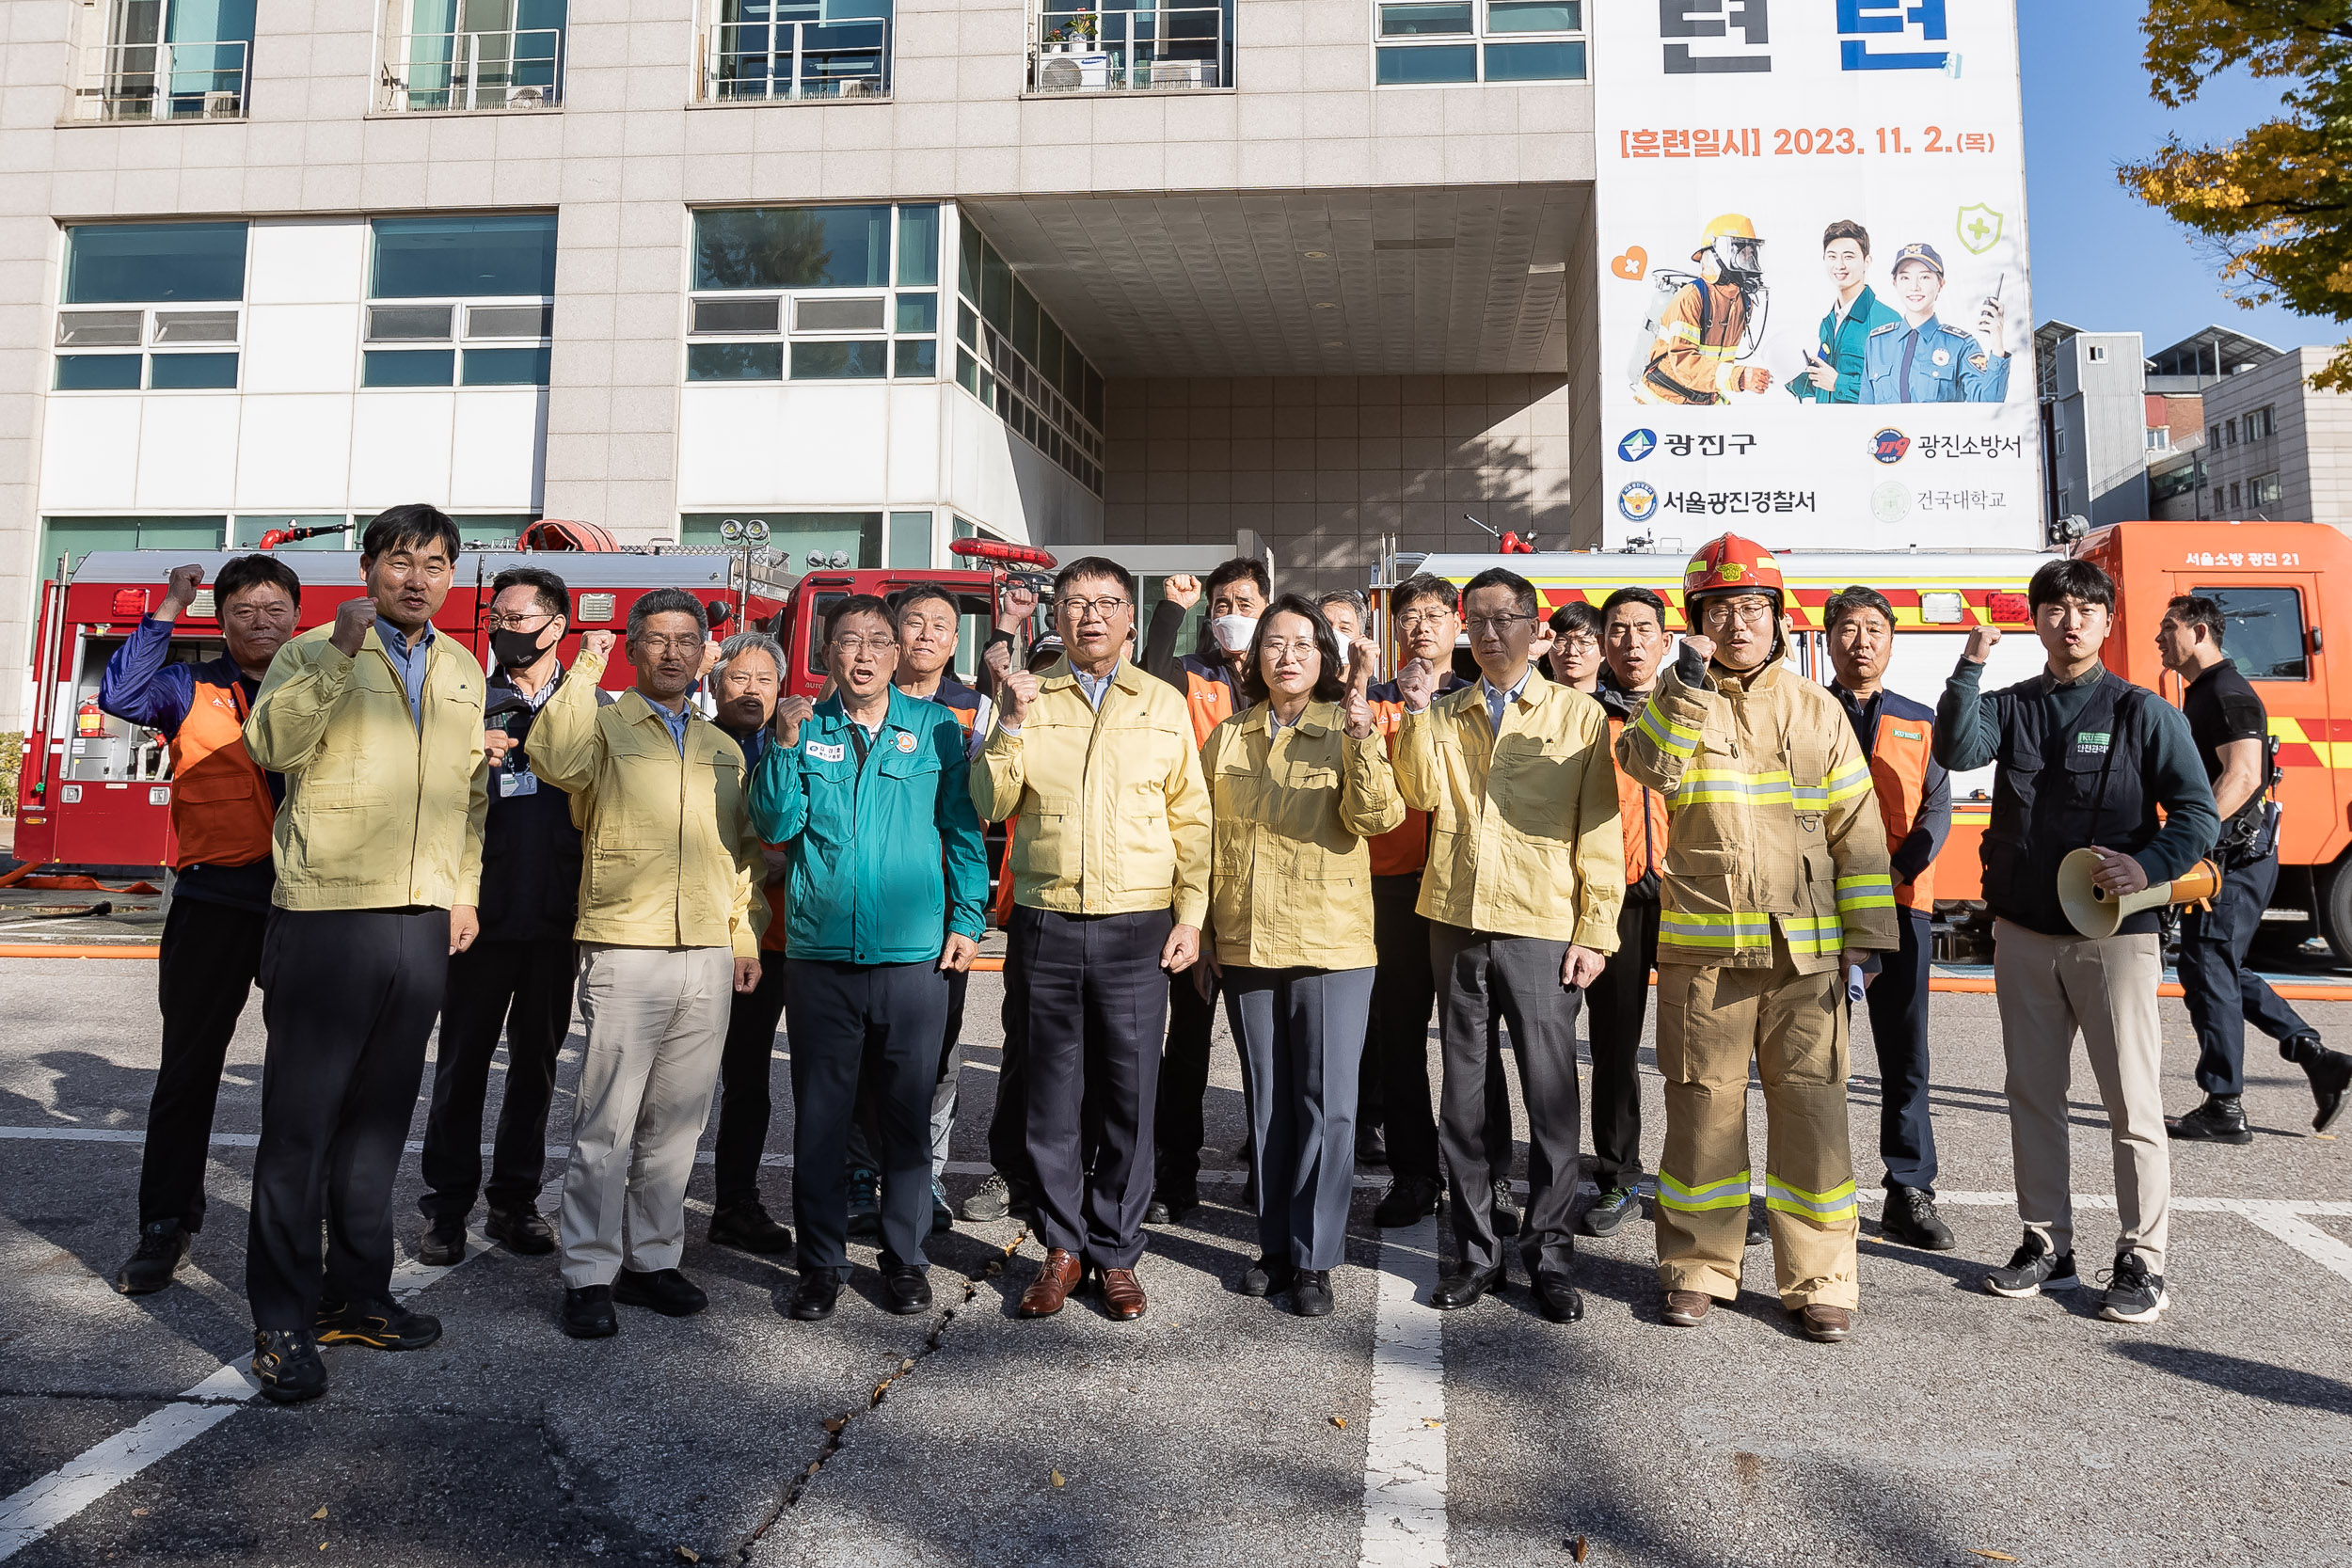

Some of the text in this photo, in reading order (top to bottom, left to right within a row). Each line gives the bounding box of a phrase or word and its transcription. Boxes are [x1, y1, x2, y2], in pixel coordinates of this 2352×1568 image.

[1621, 128, 1760, 158] [훈련일시]
[1773, 128, 1865, 155] 2023.
[1876, 127, 1912, 153] 11.
[1664, 434, 1758, 456] 광진구
[1917, 435, 2022, 459] 광진소방서
[1663, 490, 1816, 515] 서울광진경찰서
[1917, 490, 2007, 511] 건국대학교
[2185, 552, 2300, 567] 서울소방 광진 21
